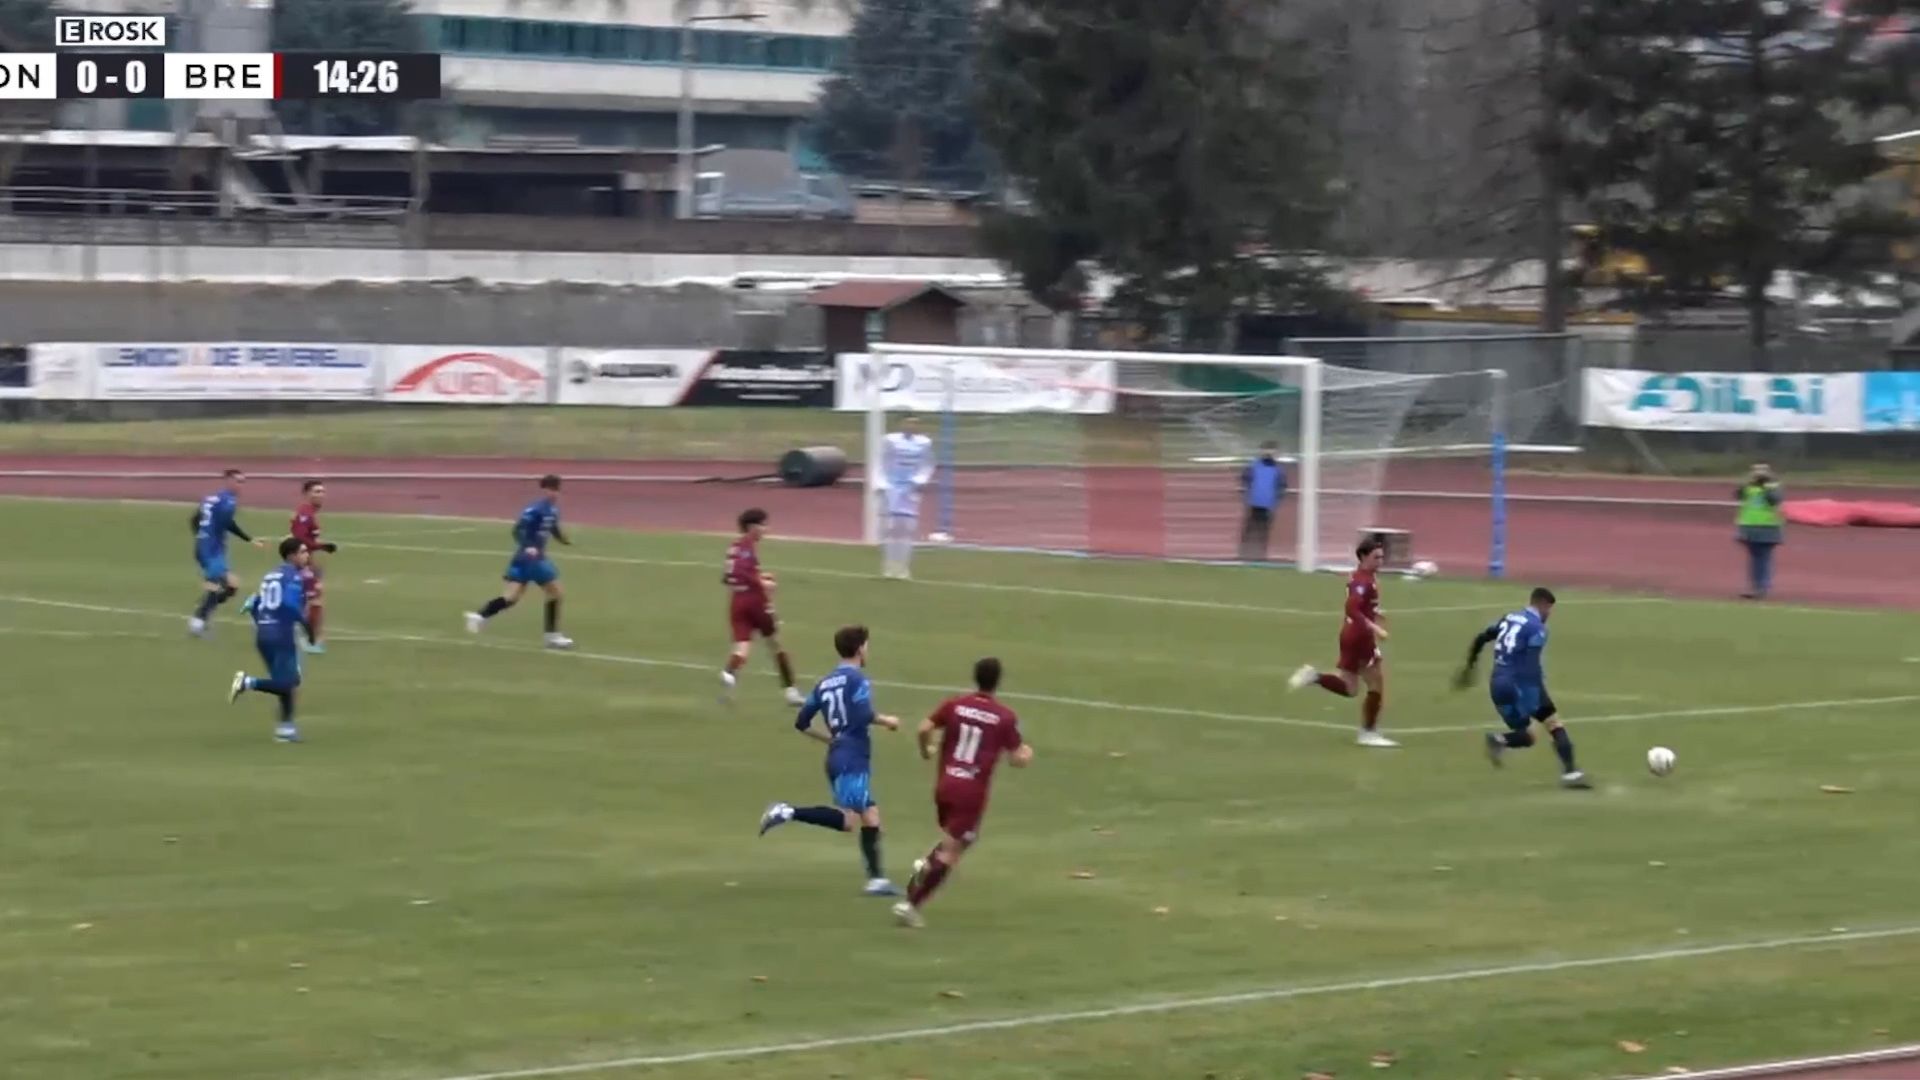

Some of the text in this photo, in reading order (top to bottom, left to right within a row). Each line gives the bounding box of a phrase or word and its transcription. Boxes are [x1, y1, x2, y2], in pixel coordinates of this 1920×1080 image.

[1495, 621, 1522, 654] 24
[821, 687, 848, 728] 21
[953, 722, 983, 764] 11
